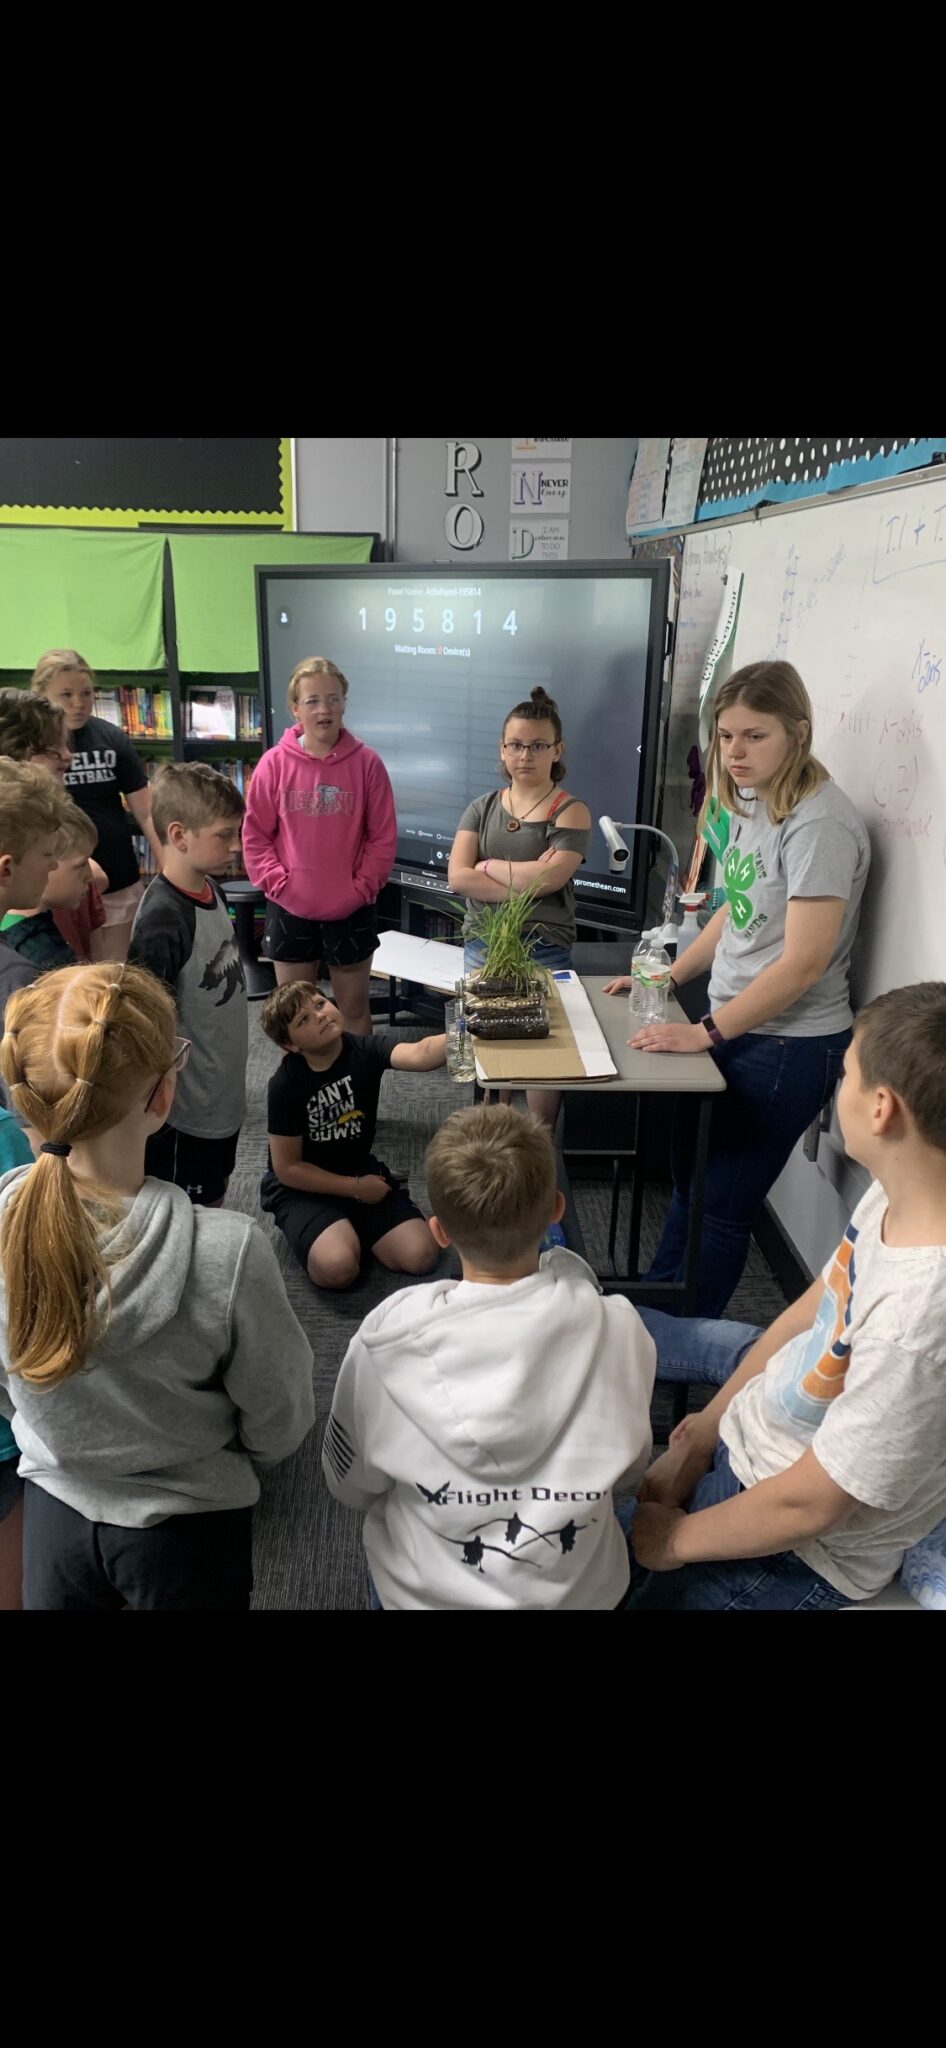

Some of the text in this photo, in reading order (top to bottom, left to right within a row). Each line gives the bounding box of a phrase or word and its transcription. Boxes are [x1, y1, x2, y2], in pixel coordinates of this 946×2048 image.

[513, 471, 544, 505] N
[541, 478, 569, 488] NEVER
[511, 526, 535, 560] D
[394, 643, 417, 656] Waiting
[417, 644, 437, 655] Room:
[443, 646, 471, 658] Device(s)
[306, 1074, 353, 1114] CAN'T
[308, 1094, 356, 1129] SLOW
[309, 1118, 362, 1142] DOWN
[441, 1486, 609, 1507] Flight Deco
